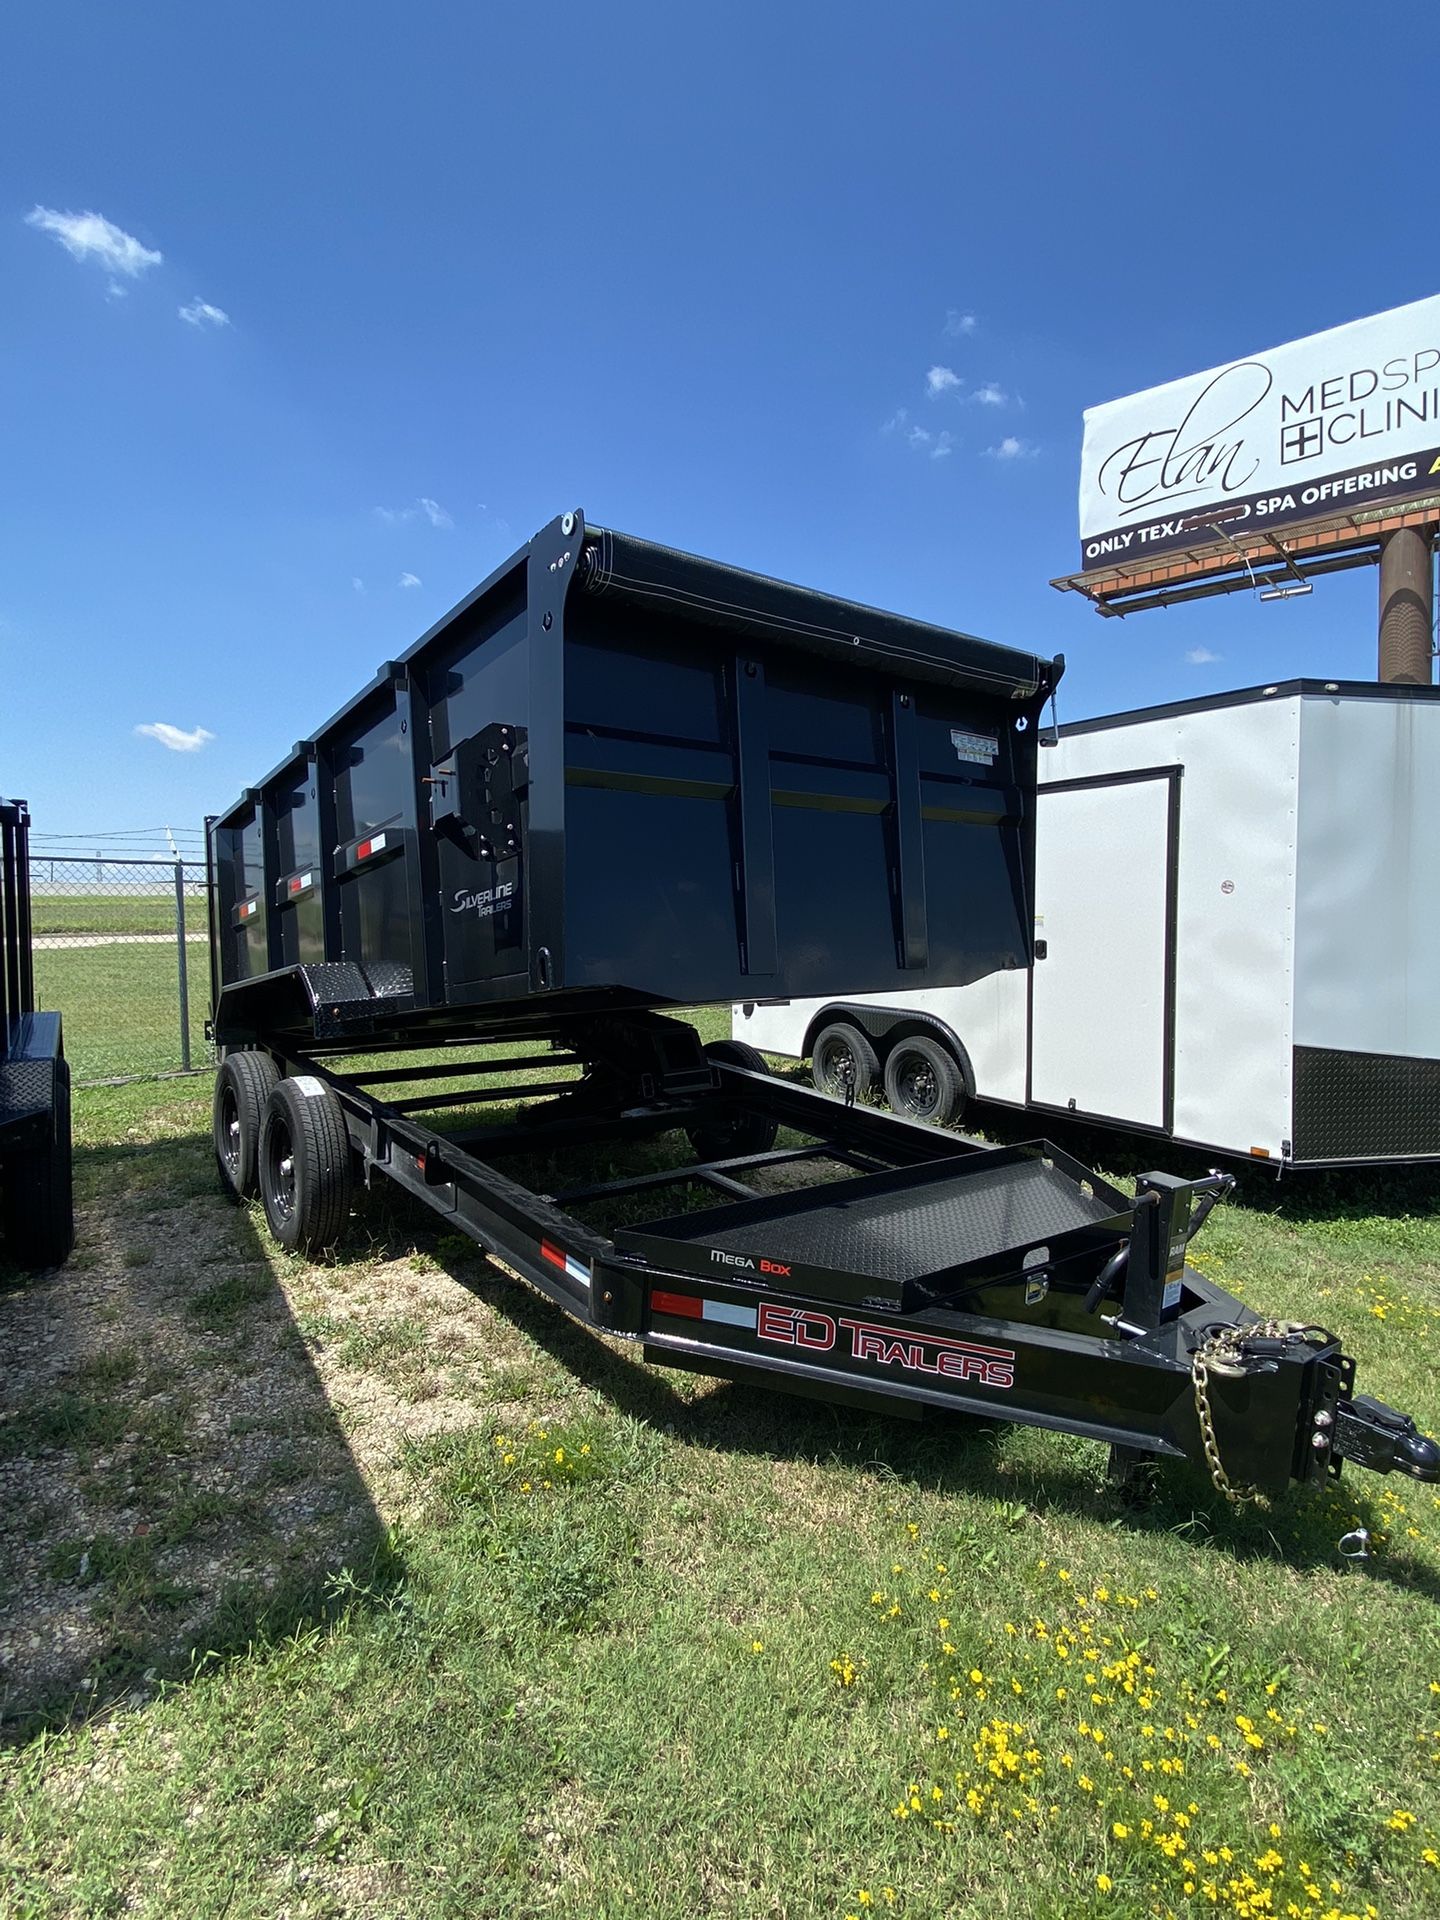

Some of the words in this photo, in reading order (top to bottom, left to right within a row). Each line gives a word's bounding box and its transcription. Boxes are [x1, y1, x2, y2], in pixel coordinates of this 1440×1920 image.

[1099, 362, 1273, 503] Elan
[1086, 531, 1134, 558] ONLY
[1138, 515, 1199, 543] TEXA
[1255, 494, 1297, 516] SPA
[1301, 462, 1417, 505] OFFERING
[450, 882, 513, 913] SILVERLINE
[477, 899, 512, 918] TRAILERS
[710, 1249, 755, 1269] MEGA
[760, 1259, 792, 1277] BOX
[838, 1318, 1016, 1388] TRAILERS
